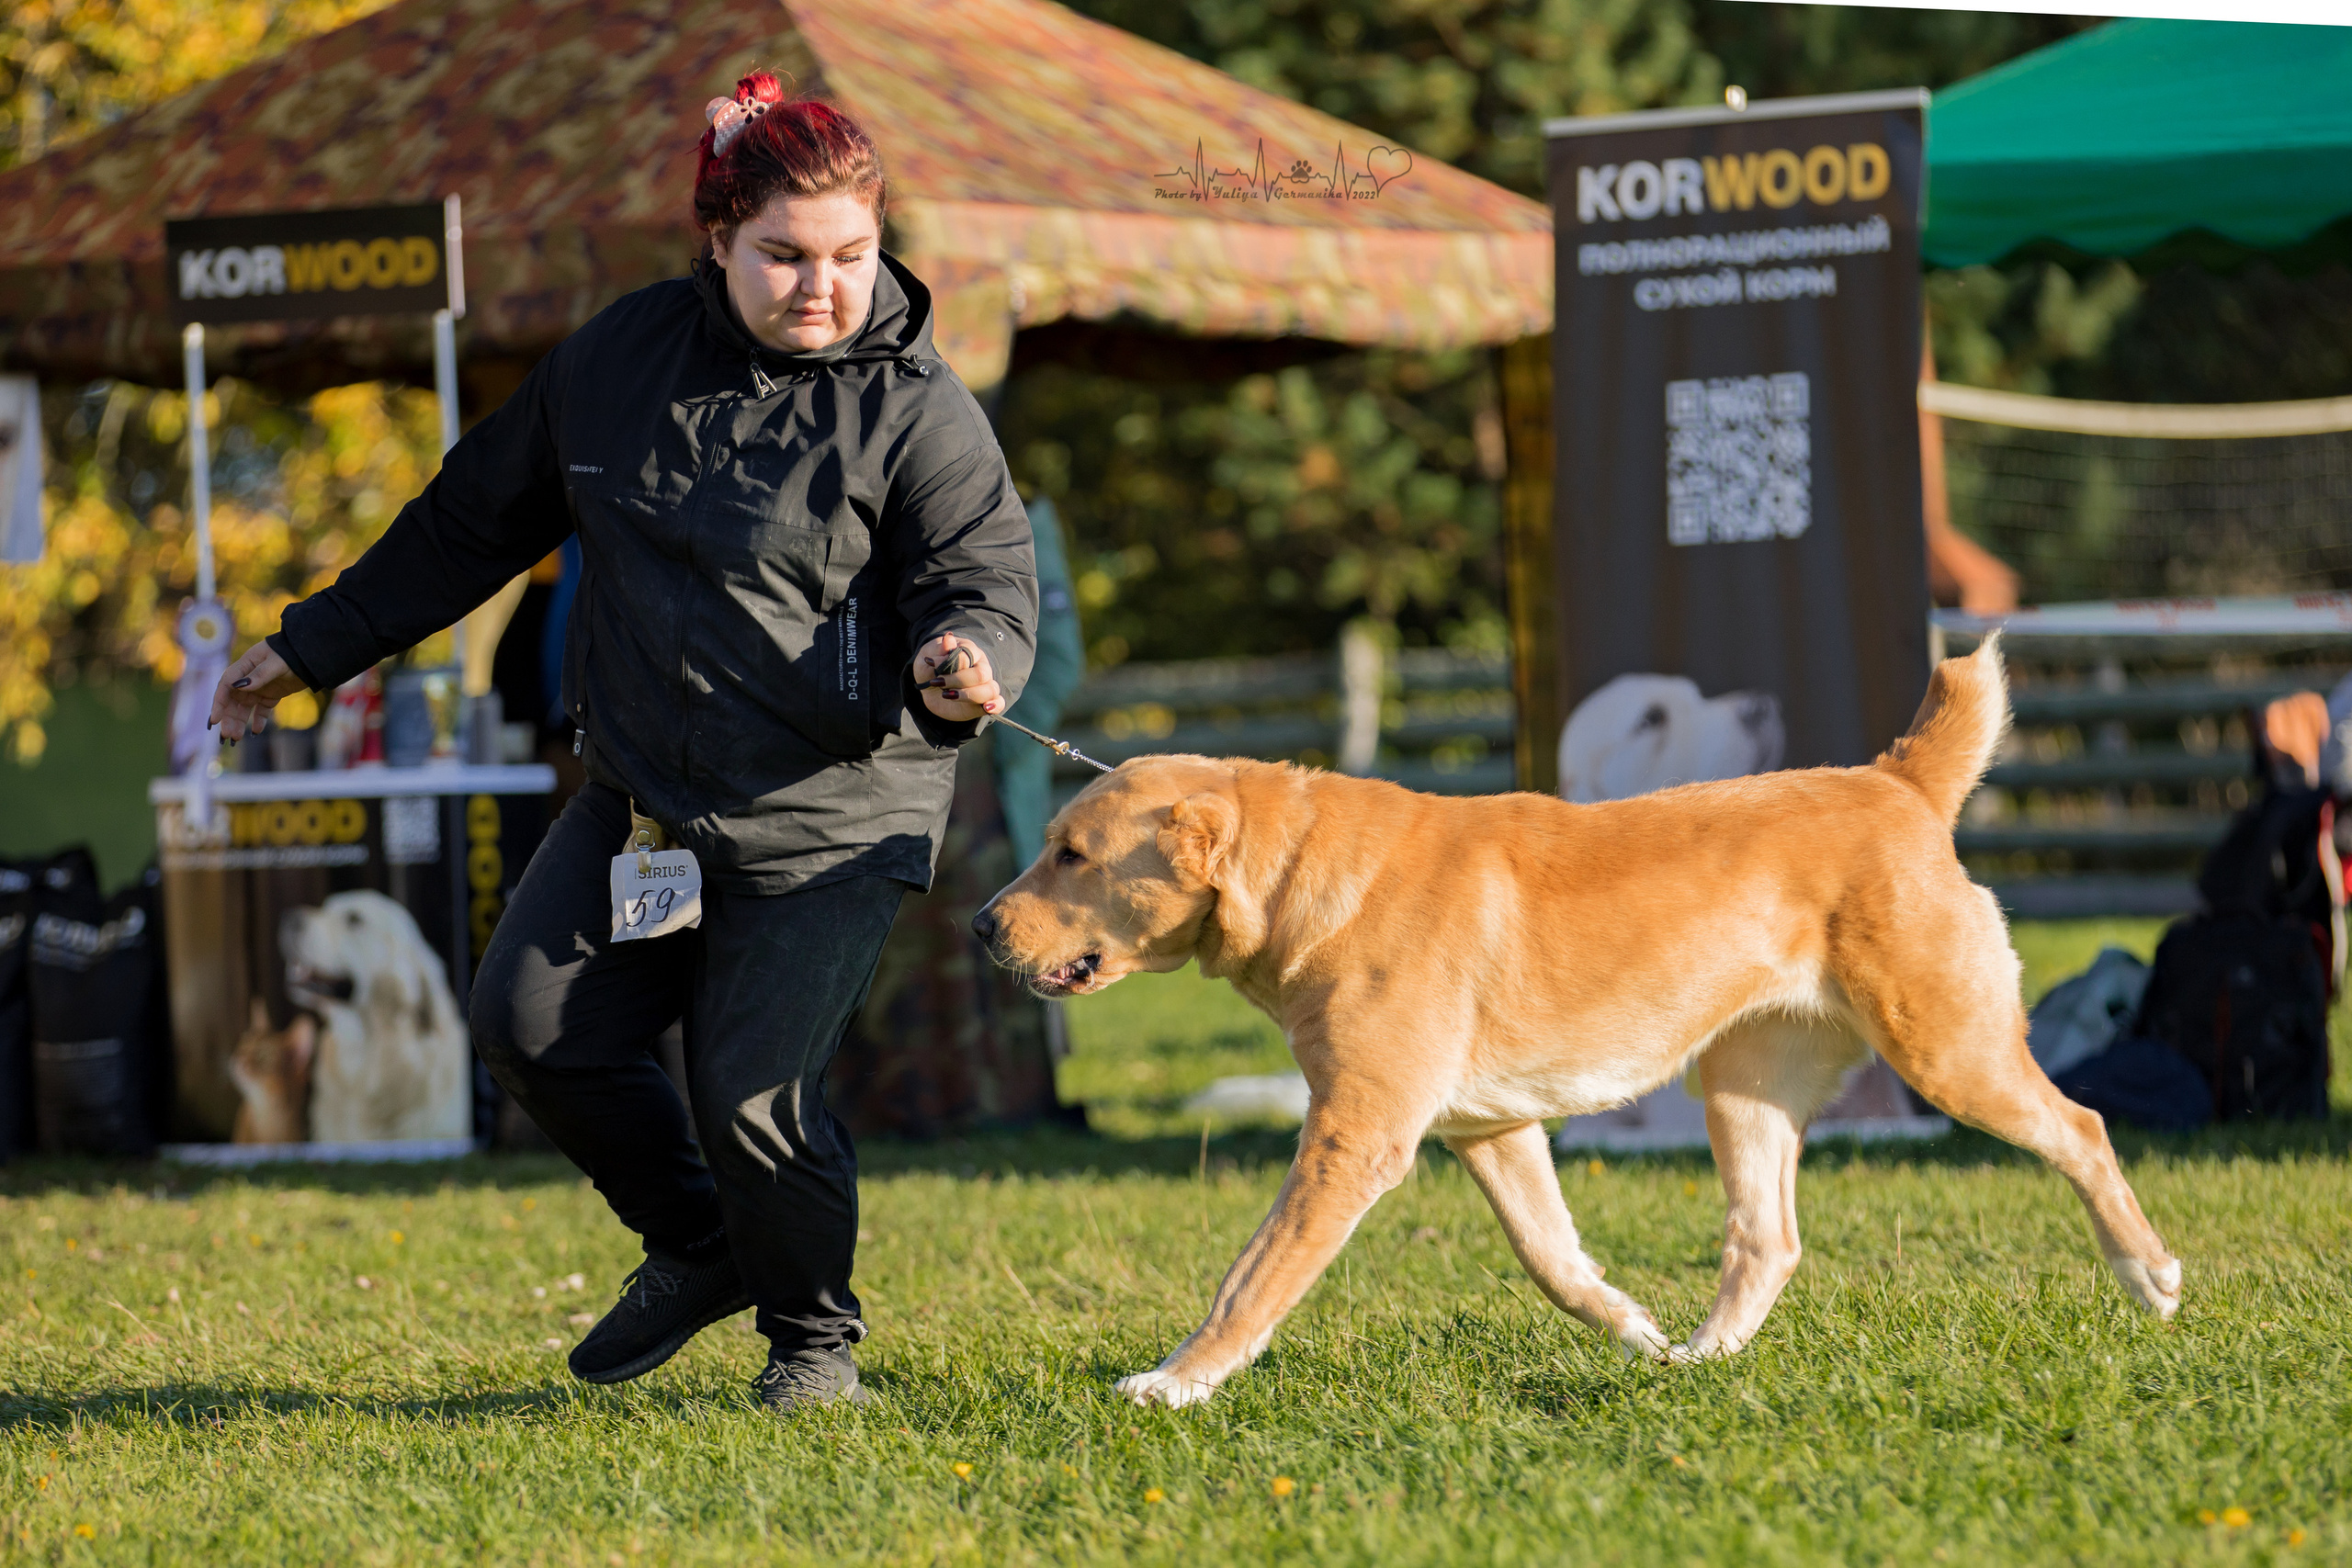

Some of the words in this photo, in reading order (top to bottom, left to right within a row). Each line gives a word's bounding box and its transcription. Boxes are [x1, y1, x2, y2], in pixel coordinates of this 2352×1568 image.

[1577, 141, 1893, 224] KORWOOD
[178, 235, 439, 300] KORWOOD
[846, 597, 858, 664] DENIMWEAR
[626, 887, 675, 928] 59
